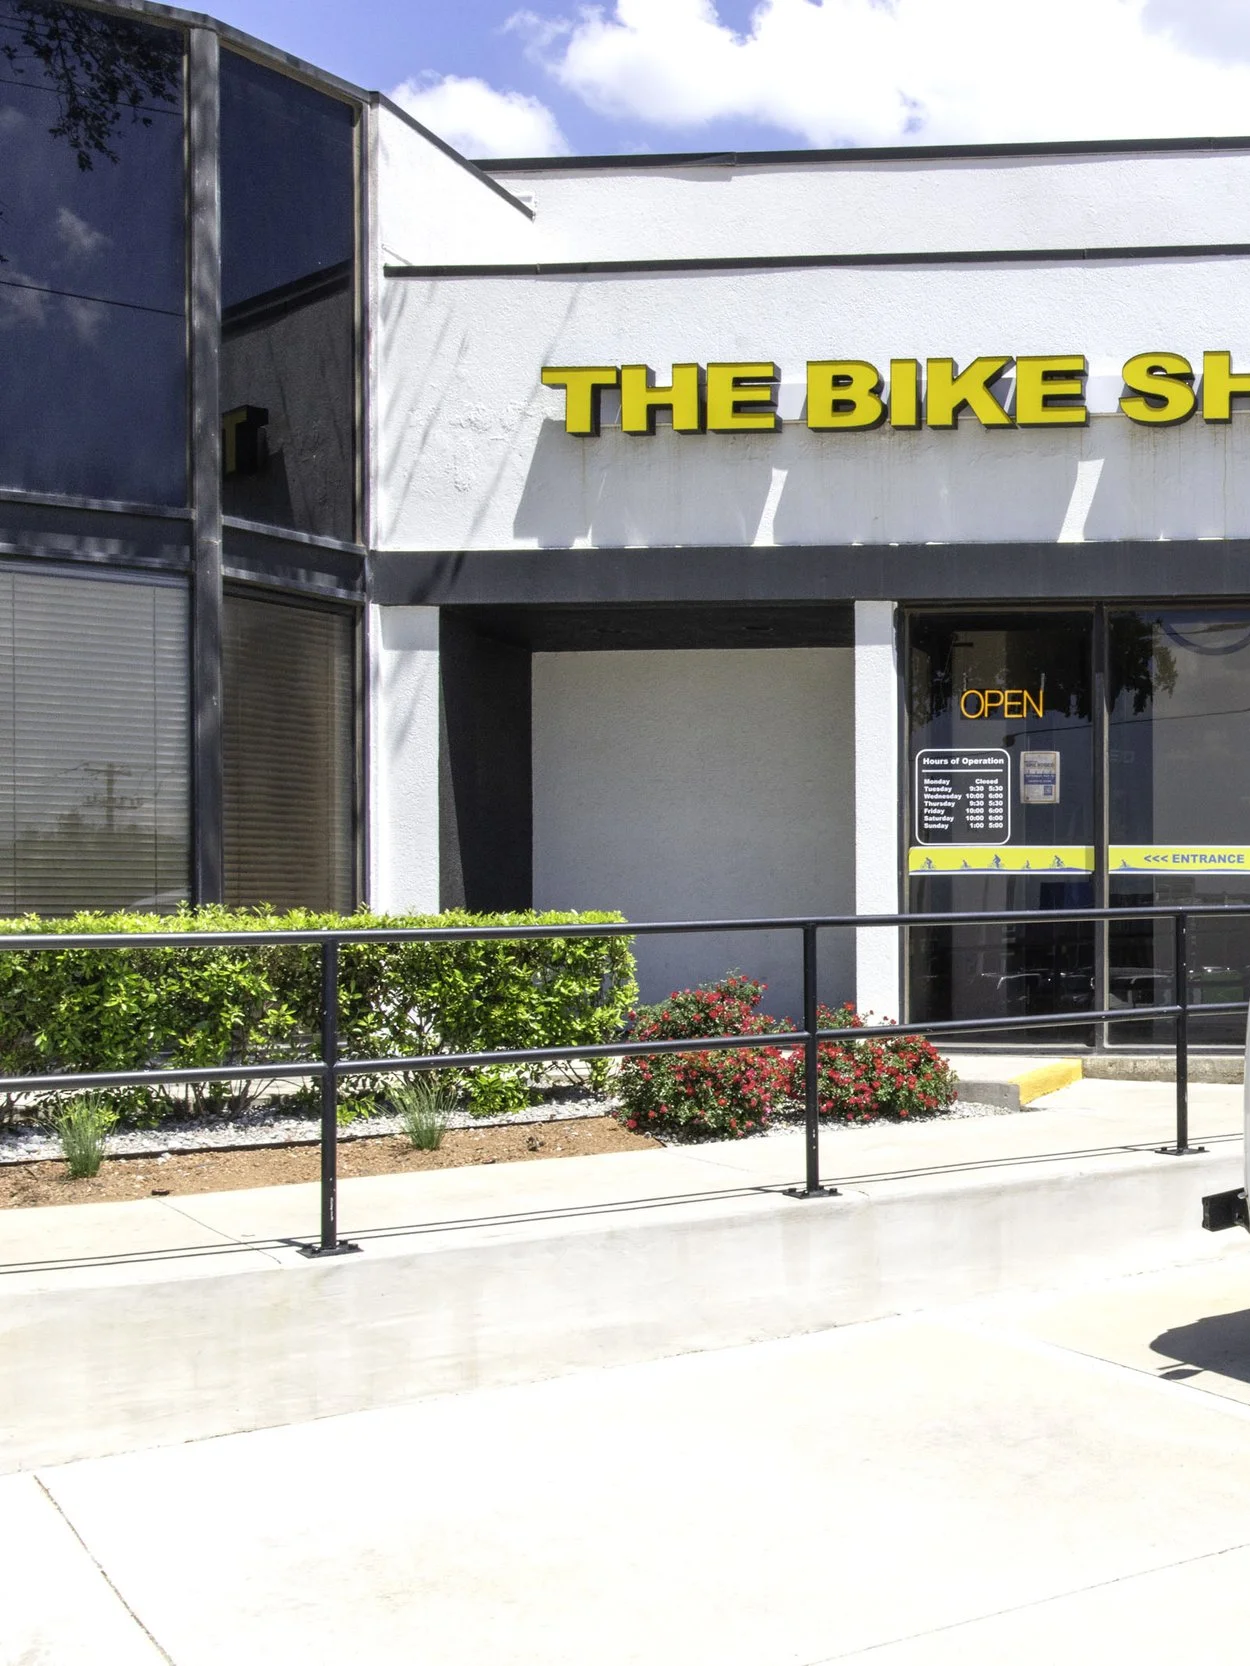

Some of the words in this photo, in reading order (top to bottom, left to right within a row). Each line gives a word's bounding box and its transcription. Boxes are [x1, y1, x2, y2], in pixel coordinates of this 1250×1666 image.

[541, 361, 782, 435] THE
[805, 353, 1089, 431] BIKE
[960, 690, 1044, 719] OPEN
[950, 757, 960, 765] of
[961, 757, 1004, 766] Operation
[924, 778, 950, 786] Monday
[924, 822, 949, 830] Sunday
[1172, 854, 1245, 864] ENTRANCE
